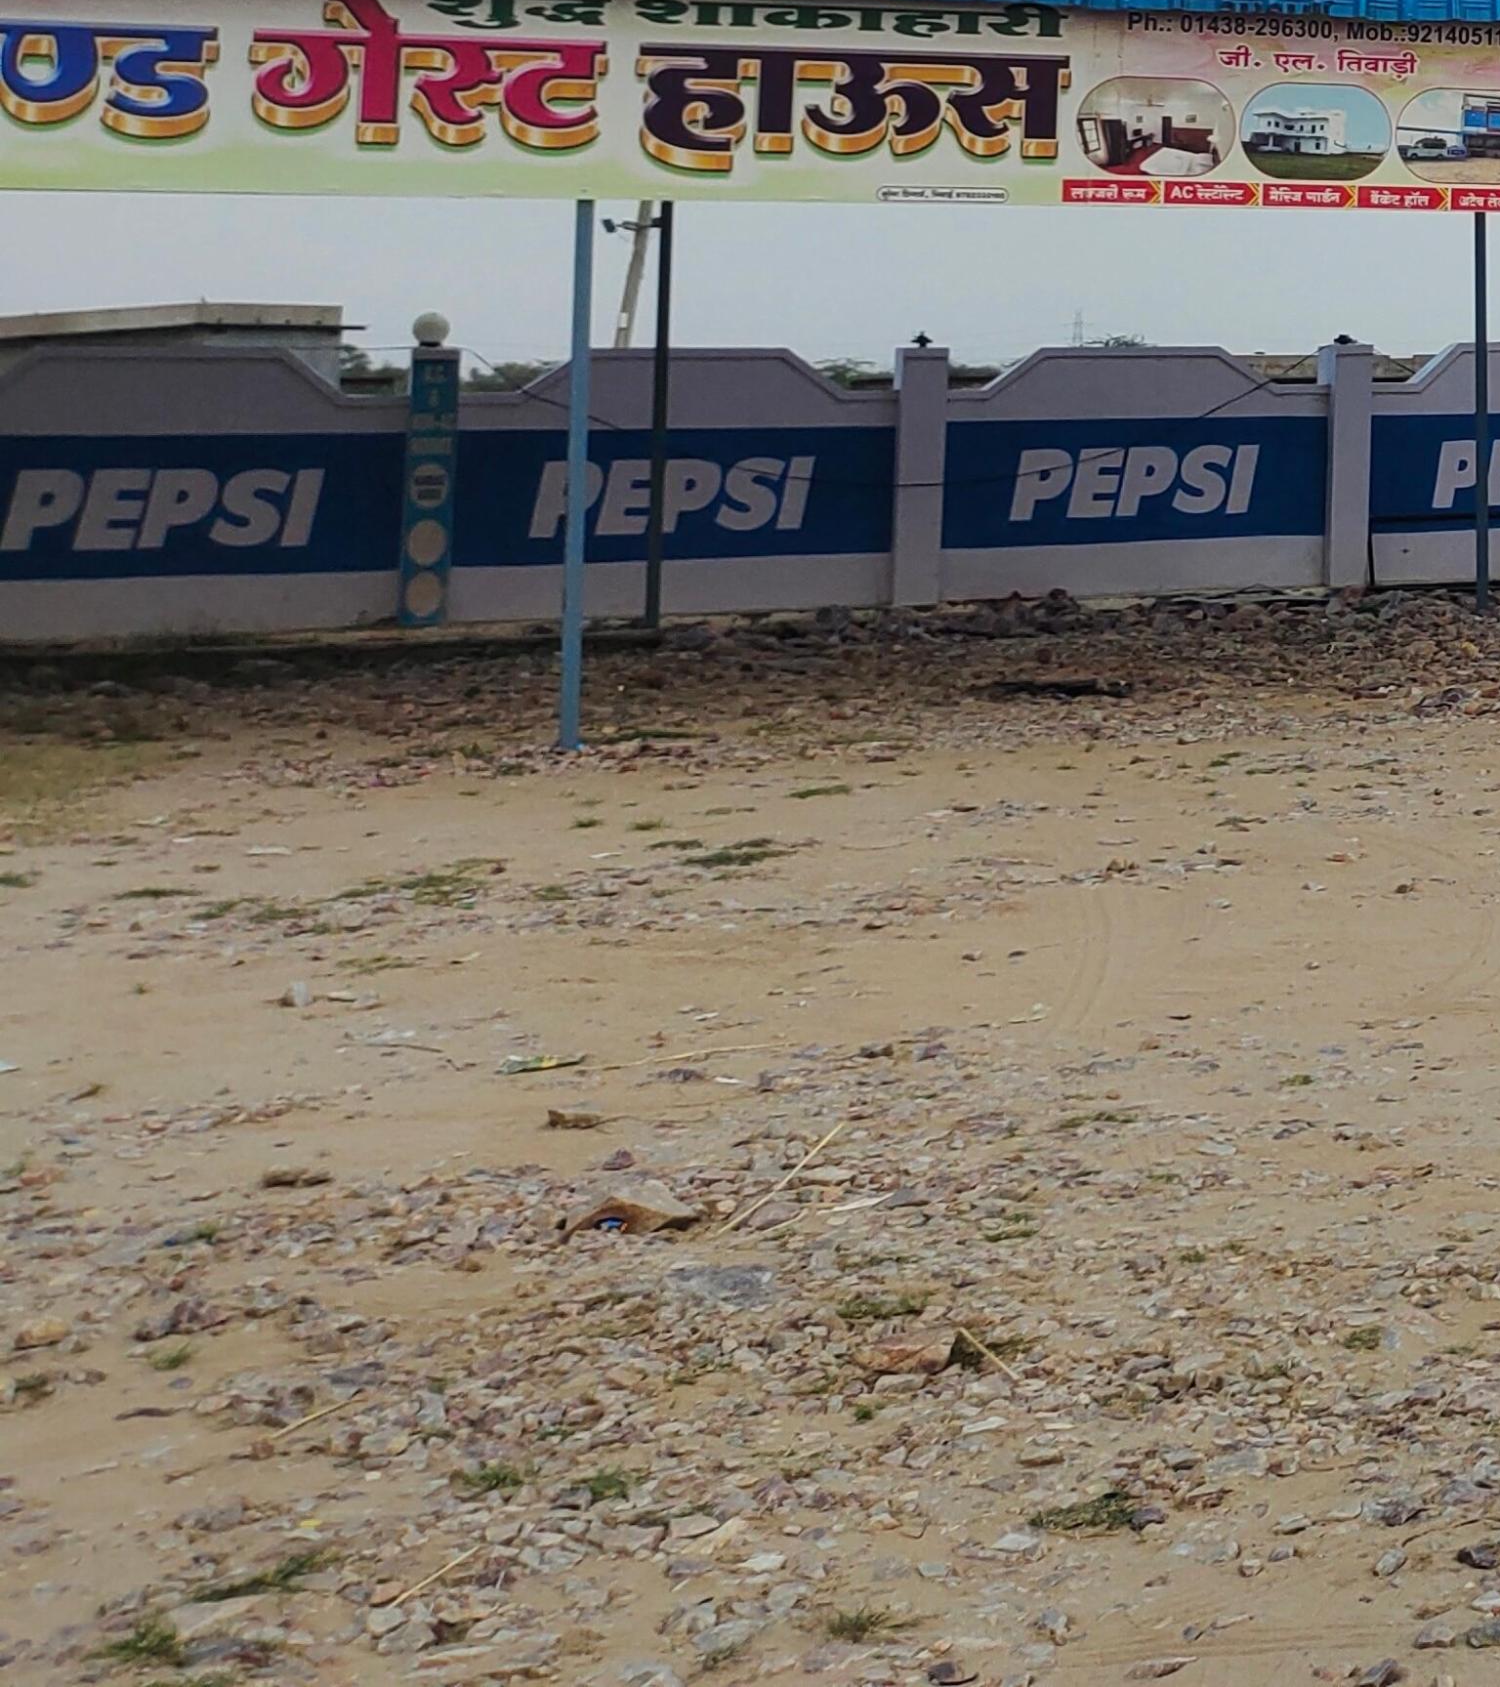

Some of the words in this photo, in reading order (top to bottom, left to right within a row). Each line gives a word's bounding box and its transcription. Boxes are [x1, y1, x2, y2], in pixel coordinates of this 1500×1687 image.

[0, 18, 219, 138] ण्ड
[635, 41, 1071, 173] हाऊस
[1170, 185, 1194, 199] AC
[0, 468, 326, 551] PEPSI
[528, 455, 817, 539] PEPSI
[1008, 444, 1260, 522] PEPSI
